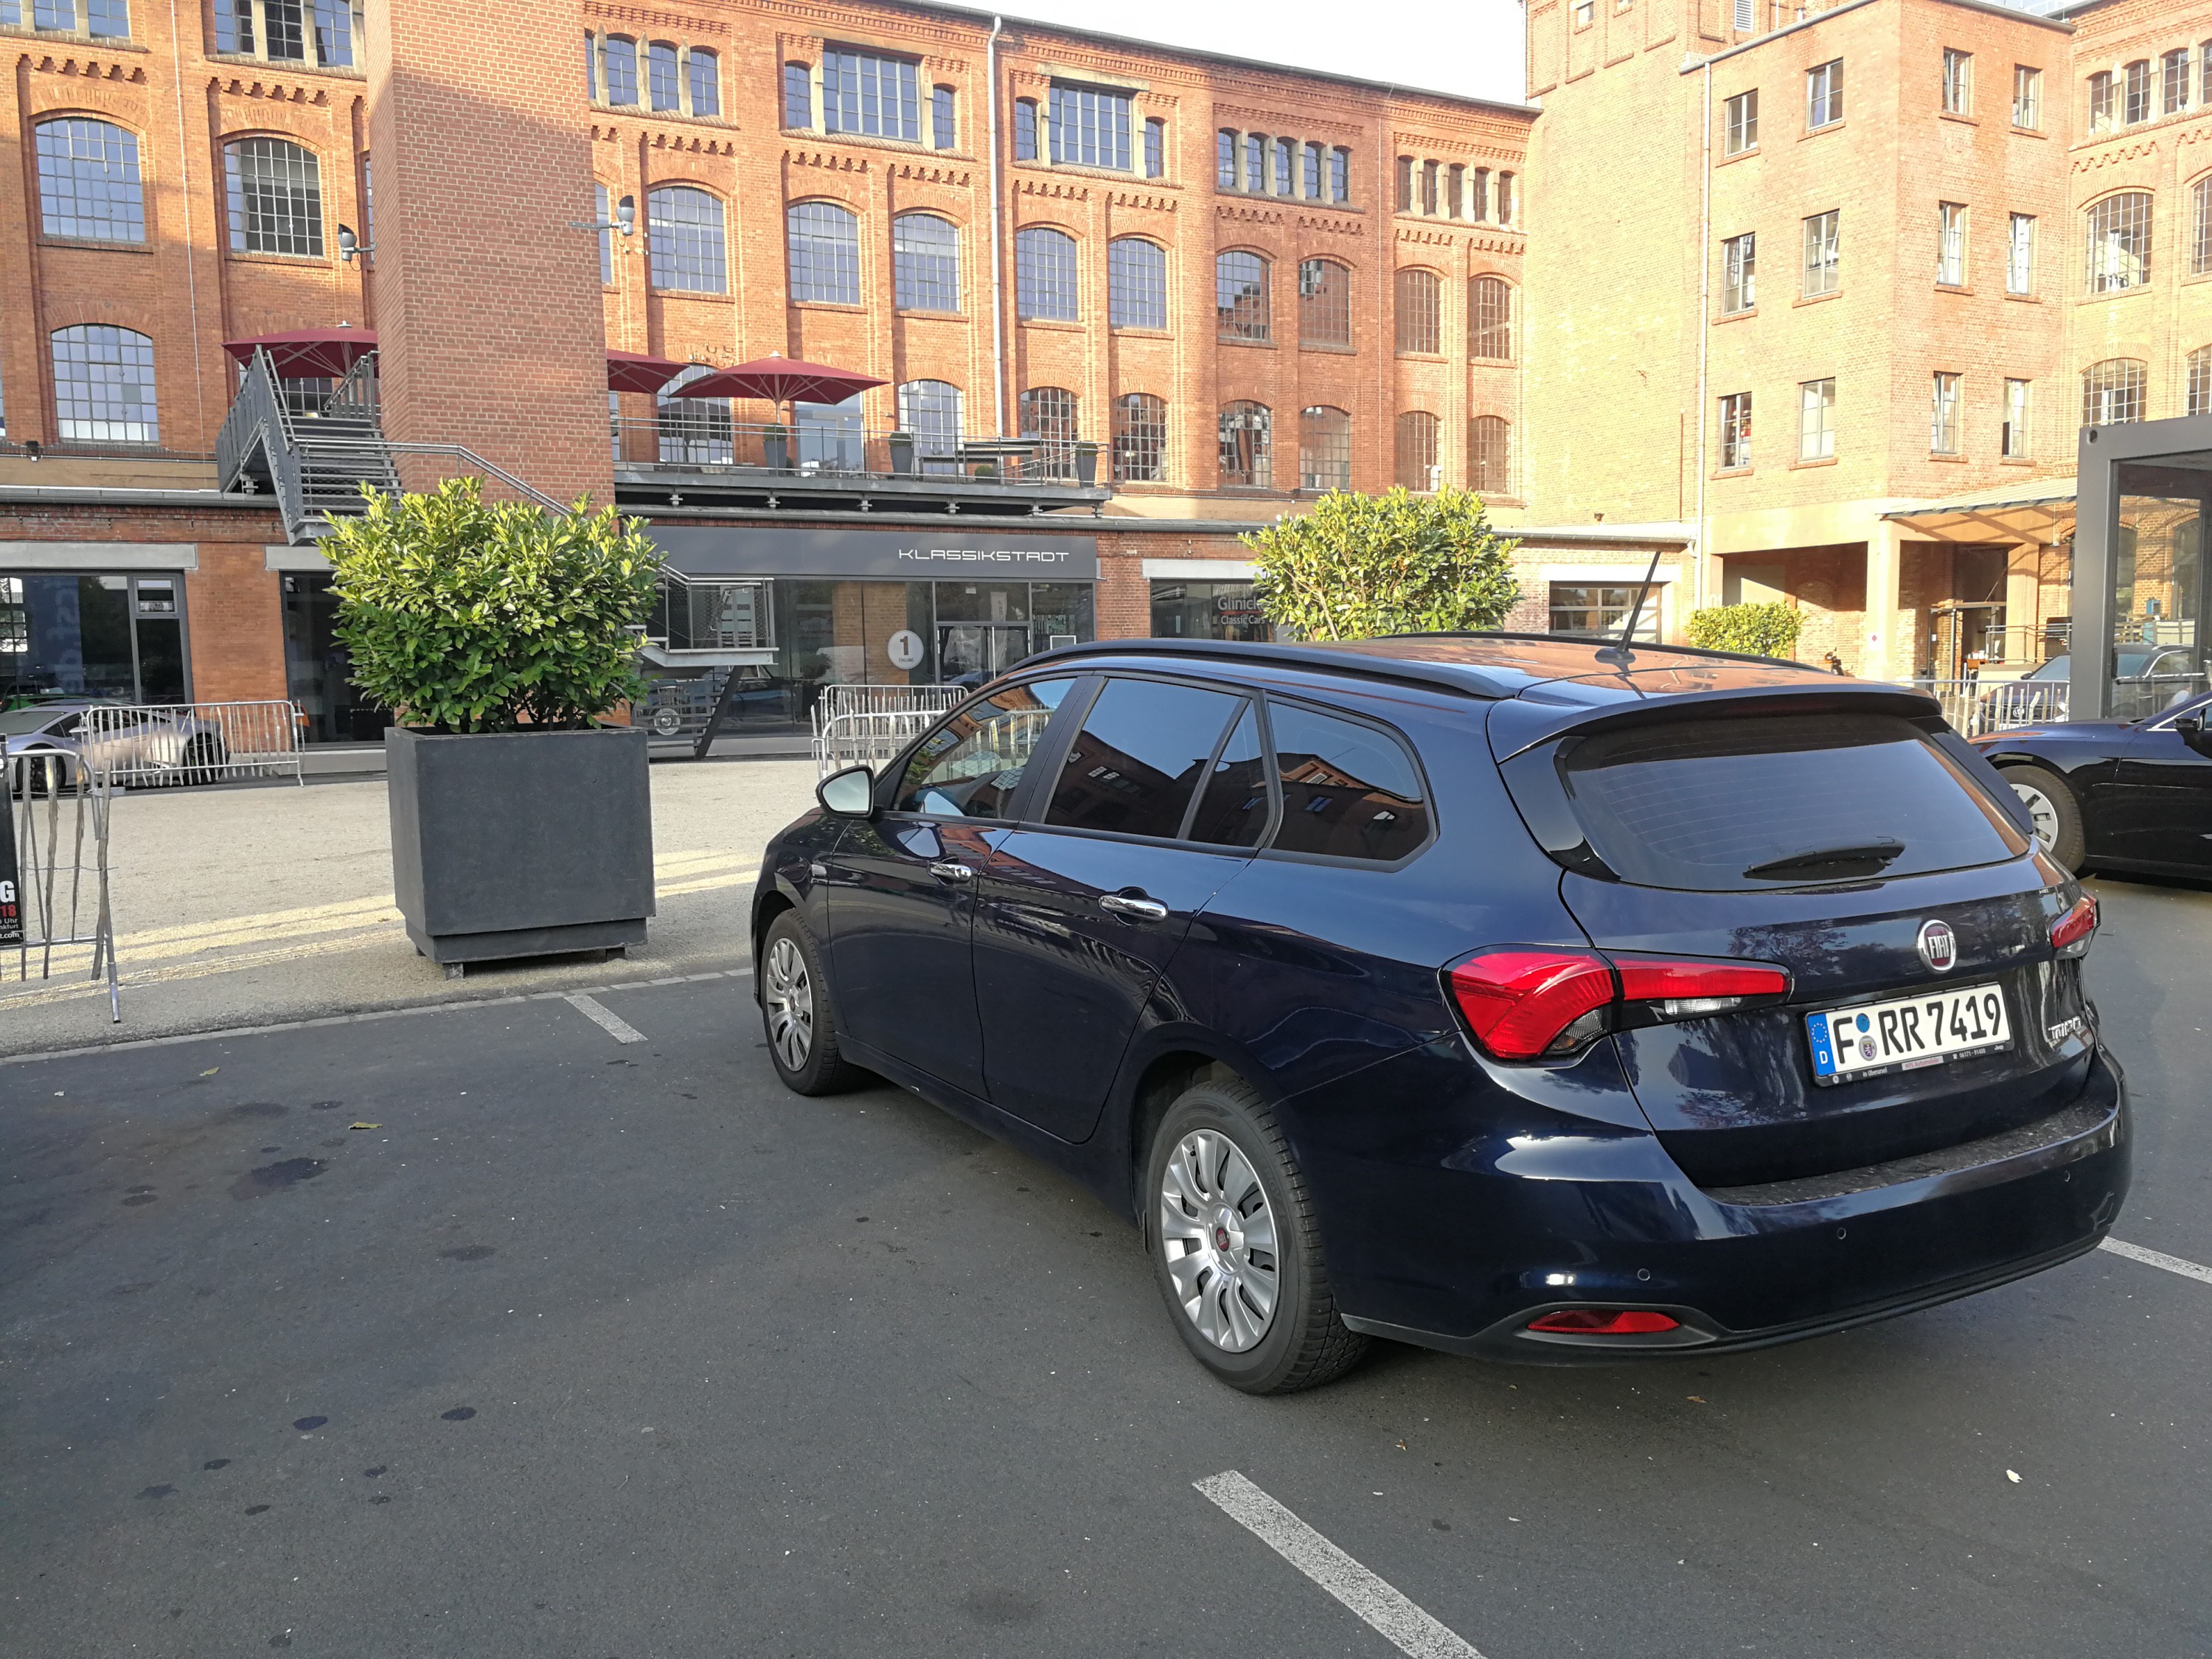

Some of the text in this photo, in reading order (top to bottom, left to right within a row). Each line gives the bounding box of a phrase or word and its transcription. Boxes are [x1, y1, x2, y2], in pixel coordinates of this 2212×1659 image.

[898, 549, 1069, 562] KLASSIKSTADT
[1217, 596, 1262, 611] Glinick
[1221, 615, 1265, 625] Classic Cars
[900, 636, 909, 655] 1
[1927, 934, 1950, 959] FIAT
[1832, 993, 2001, 1064] F RR 7419
[1819, 1051, 1829, 1064] D
[1915, 1058, 1939, 1066] Automobile
